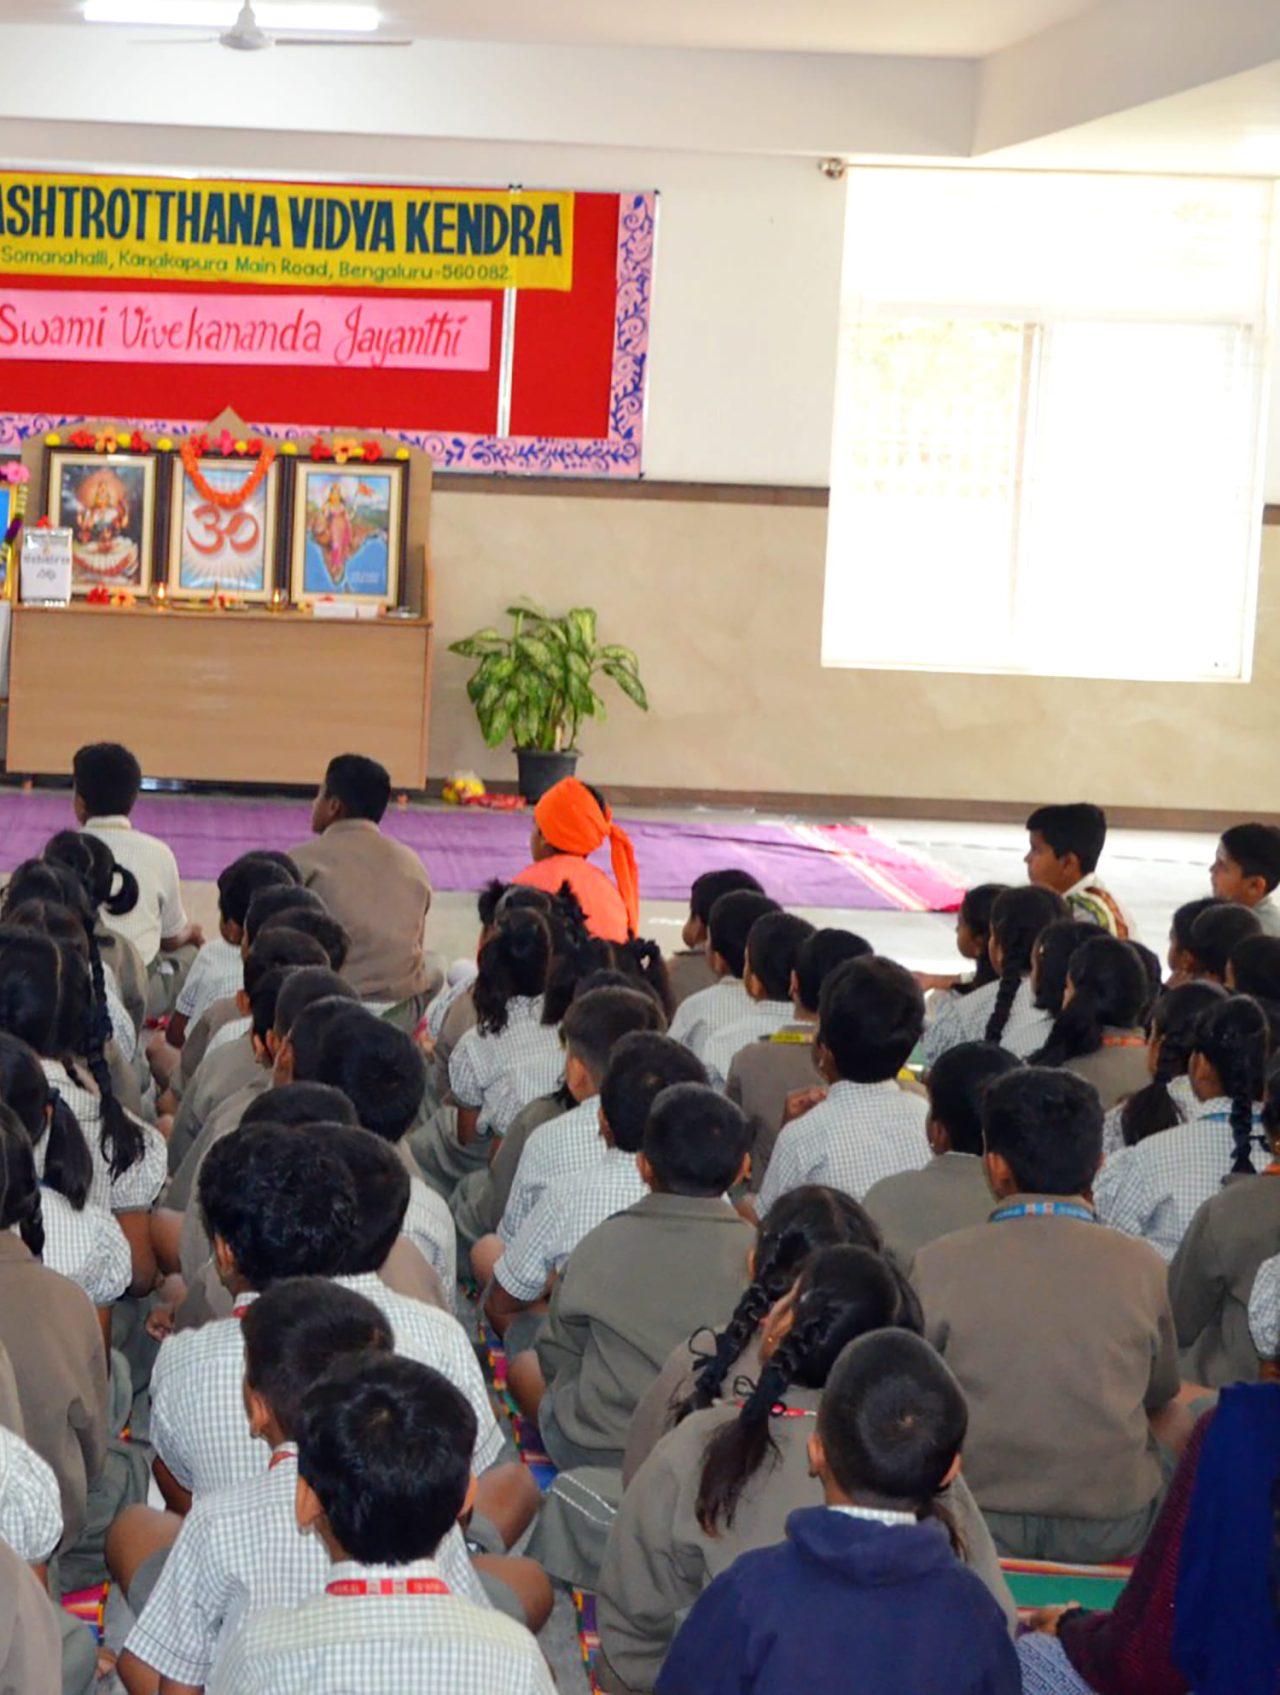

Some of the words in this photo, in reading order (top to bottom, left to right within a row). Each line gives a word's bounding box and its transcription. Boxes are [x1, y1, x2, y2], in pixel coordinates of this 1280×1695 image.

[287, 196, 396, 253] VIDYA
[404, 202, 564, 257] KENDRA
[0, 244, 115, 271] Somanahalli,
[119, 249, 229, 272] Kanakapura
[234, 256, 277, 275] Main
[280, 257, 334, 280] Road,
[120, 305, 321, 352] Vivekananda
[333, 303, 468, 368] Jayanthi
